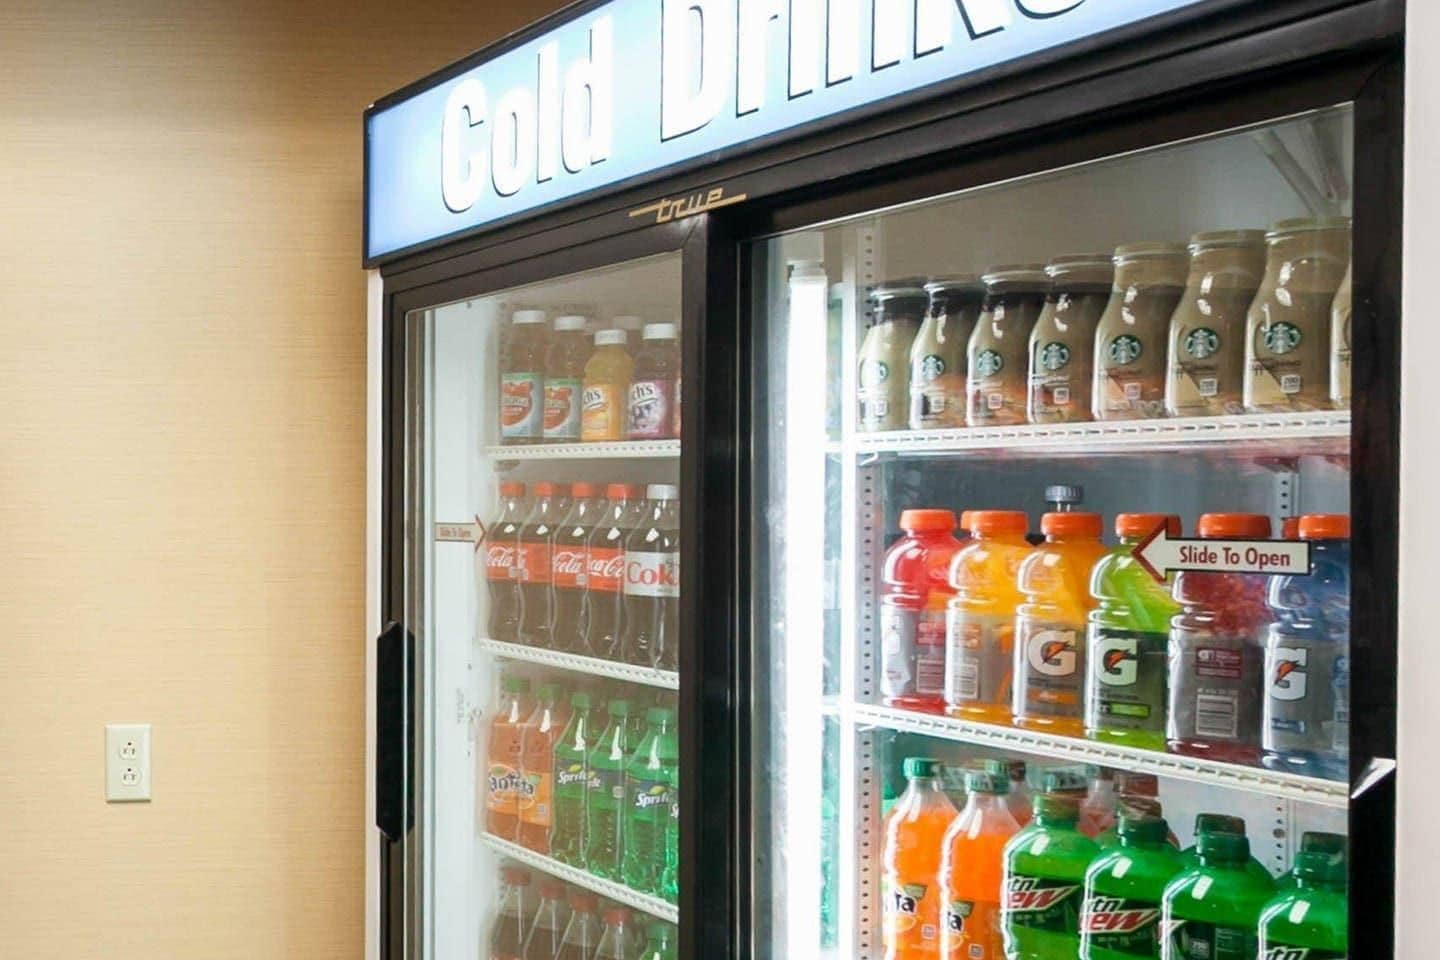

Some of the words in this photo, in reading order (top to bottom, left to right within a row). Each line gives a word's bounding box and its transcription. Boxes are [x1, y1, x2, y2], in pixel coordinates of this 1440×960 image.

[441, 14, 614, 213] Cold
[1180, 546, 1218, 564] Slide
[1222, 547, 1241, 565] To
[1245, 548, 1291, 570] Open
[1028, 630, 1078, 677] G
[1096, 637, 1139, 686] G
